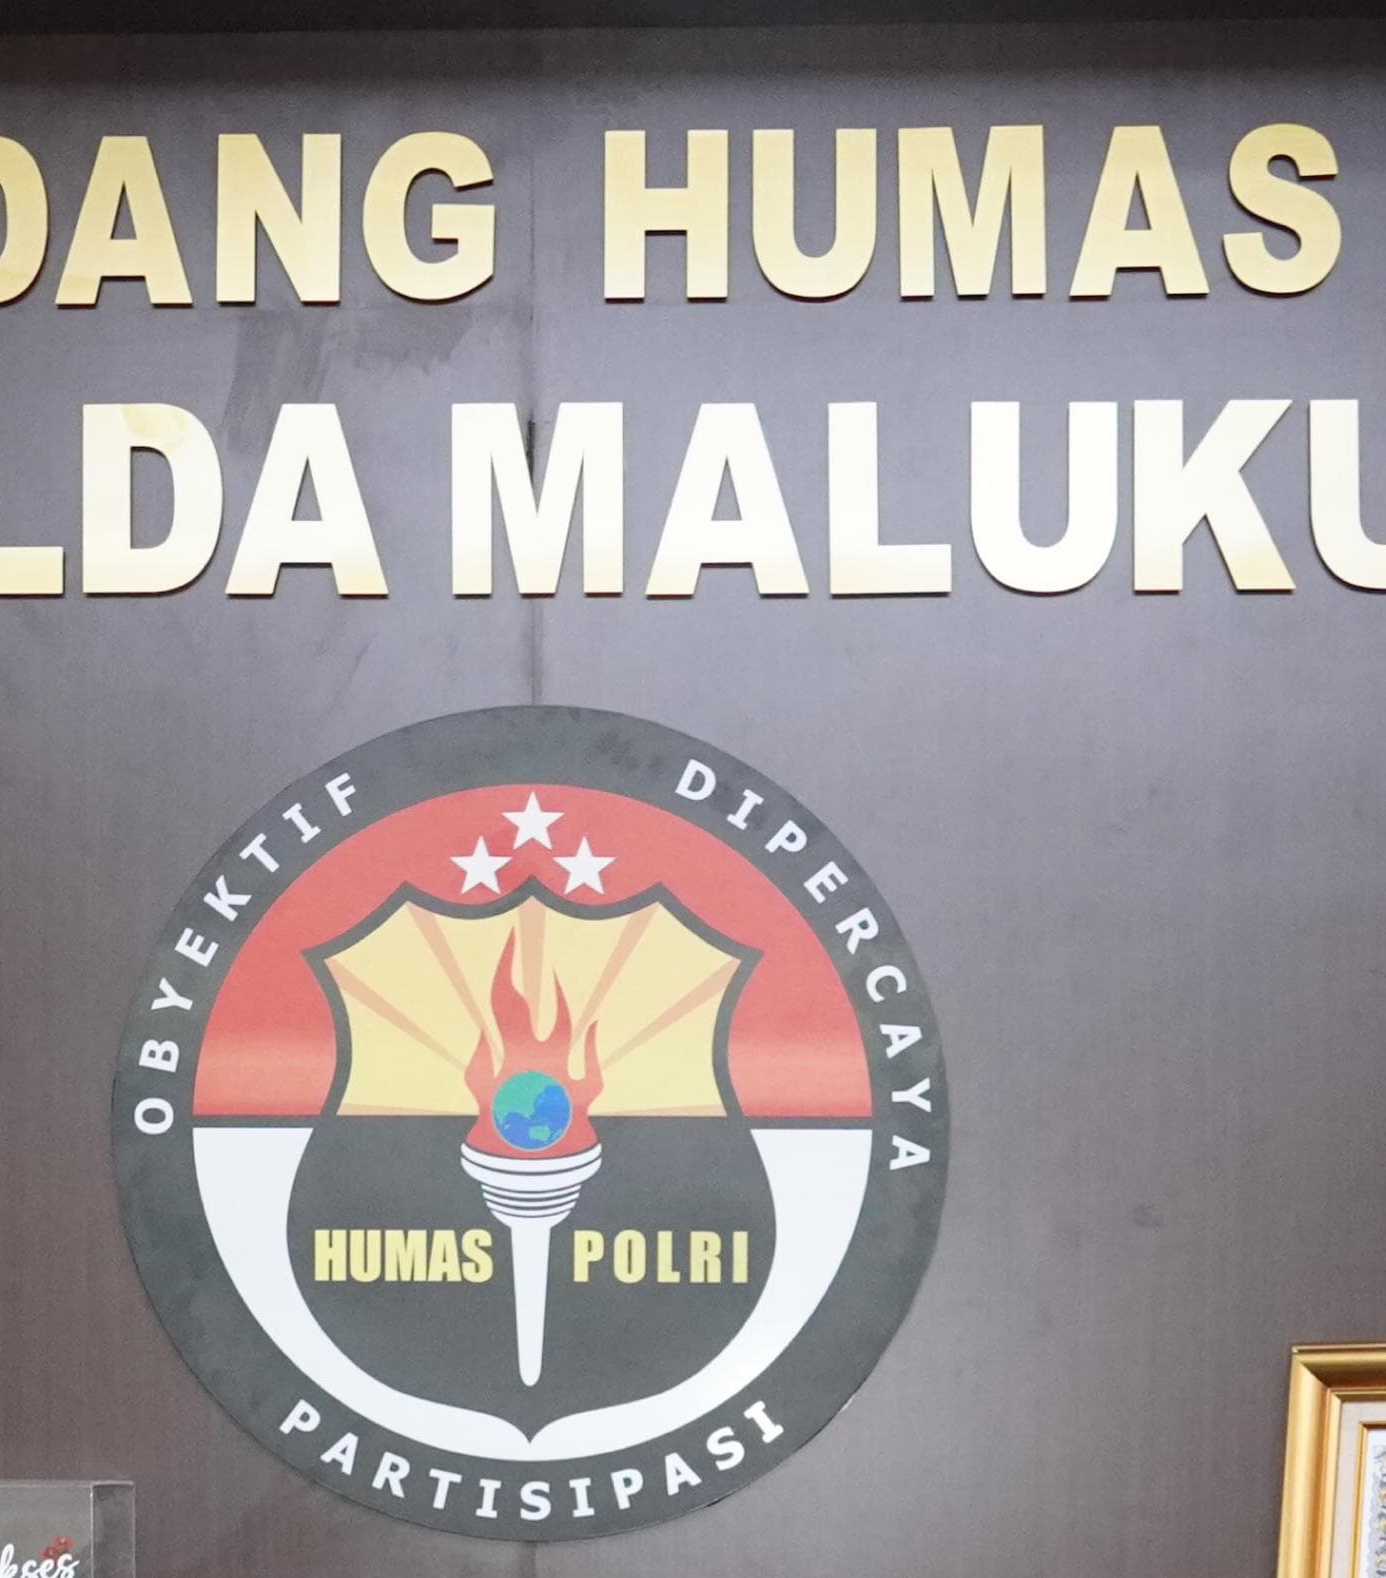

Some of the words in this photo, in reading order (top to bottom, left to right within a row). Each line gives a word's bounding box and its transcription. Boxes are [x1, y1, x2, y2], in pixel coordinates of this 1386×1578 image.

[604, 122, 1343, 300] HUMAS
[134, 772, 362, 1136] OBYEKTIF
[675, 757, 933, 1174] DIPERCAYA
[314, 1229, 494, 1283] HUMAS
[573, 1231, 750, 1284] POLRI
[280, 1399, 786, 1522] PARTISIPASI
